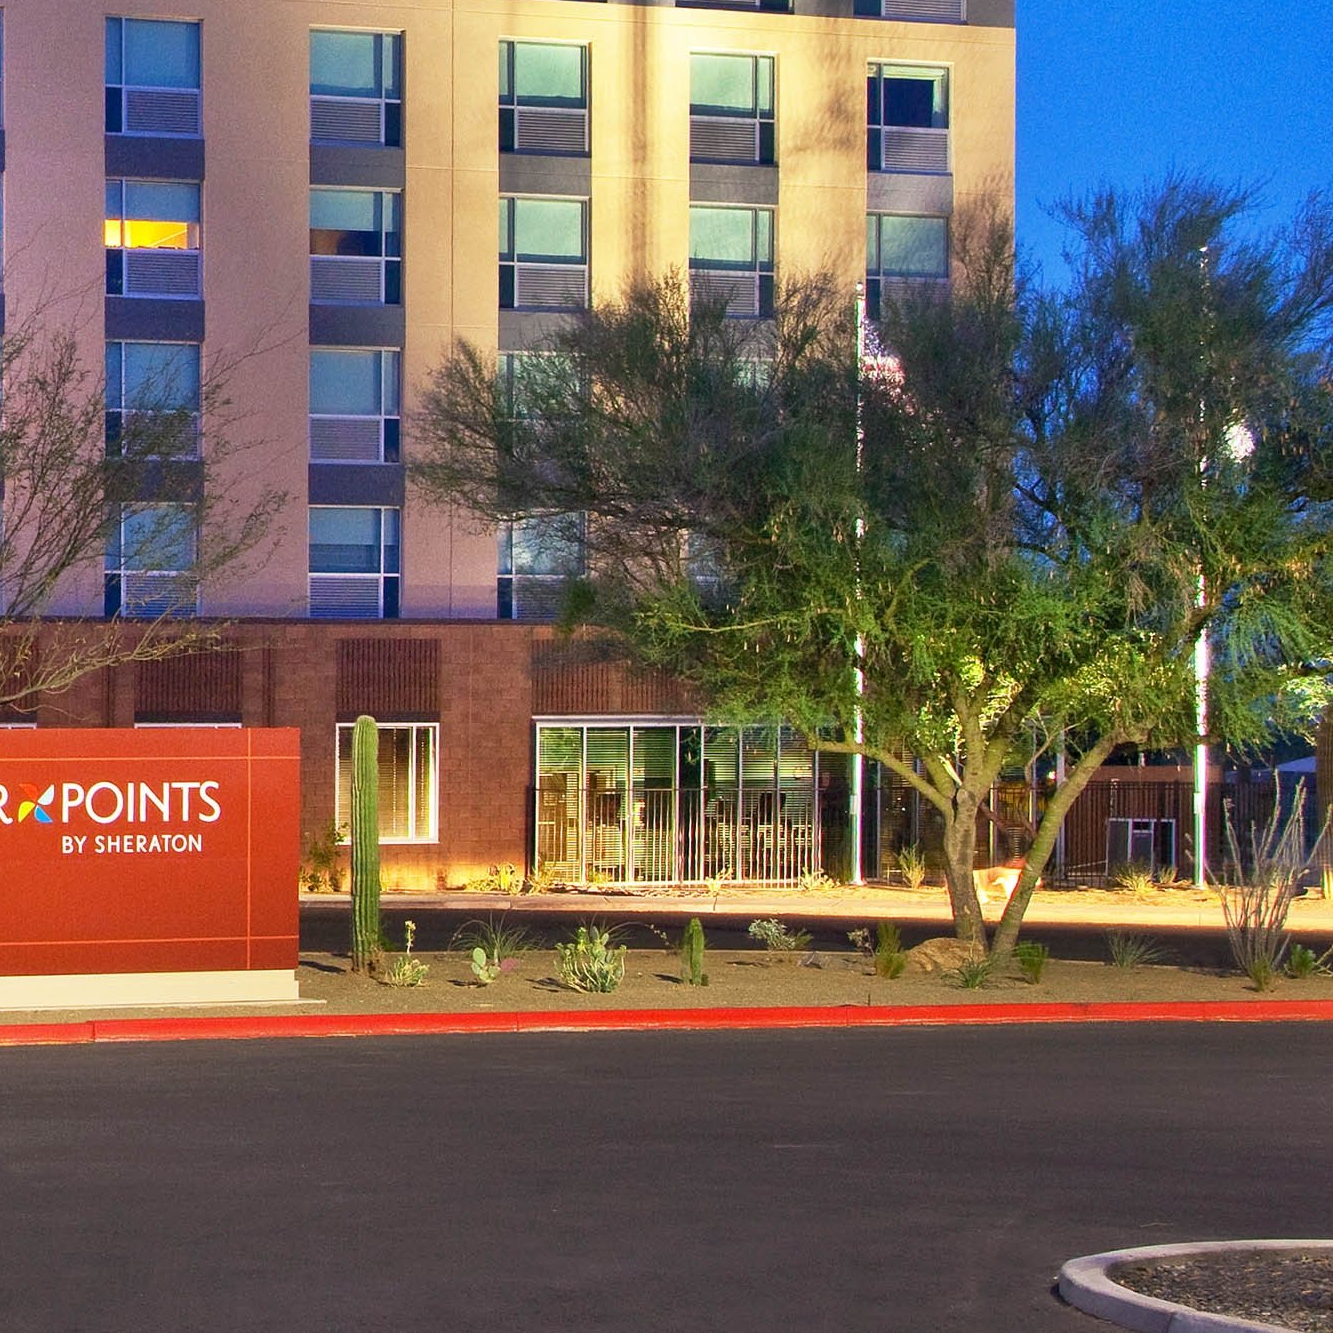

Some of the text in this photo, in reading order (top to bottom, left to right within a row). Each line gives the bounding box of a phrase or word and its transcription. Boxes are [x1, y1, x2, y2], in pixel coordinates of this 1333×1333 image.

[62, 780, 221, 824] POINTS
[62, 834, 202, 854] BY SHERATON
